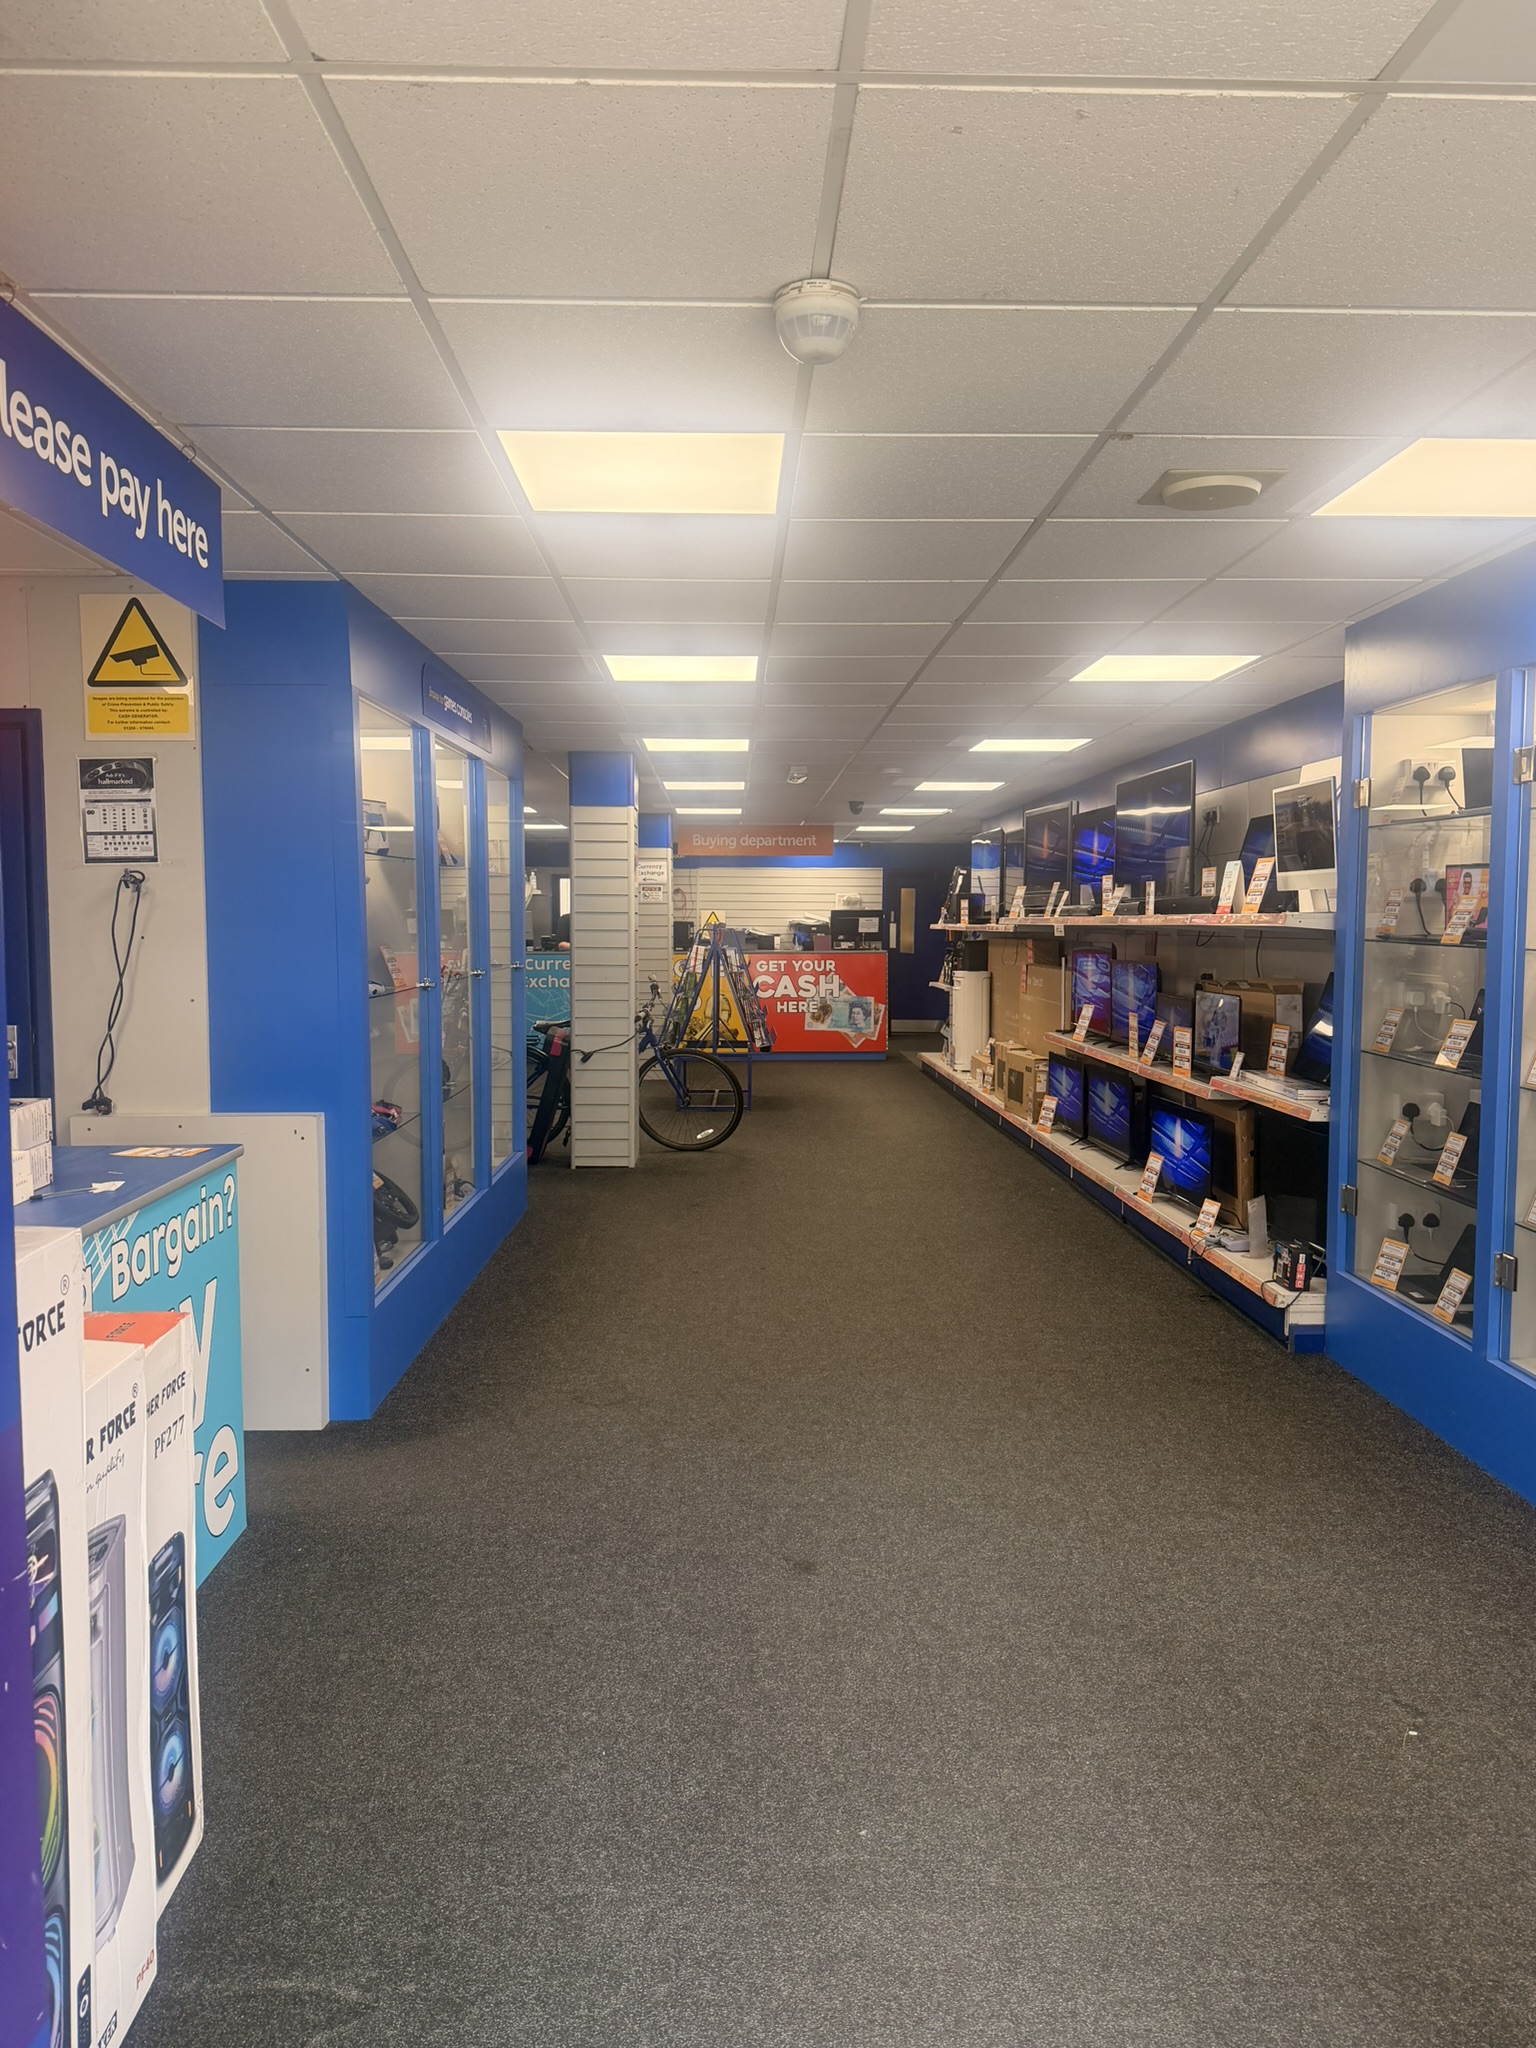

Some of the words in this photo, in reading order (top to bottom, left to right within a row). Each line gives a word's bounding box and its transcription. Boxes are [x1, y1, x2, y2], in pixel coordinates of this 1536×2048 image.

[0, 357, 92, 487] lease
[100, 450, 151, 540] pay
[156, 478, 209, 569] here
[692, 834, 737, 849] Buying
[739, 834, 817, 849] department
[753, 974, 841, 999] CASH
[756, 960, 788, 972] GET
[791, 960, 837, 972] YOUR
[776, 1001, 820, 1013] HERE
[110, 1173, 236, 1302] Bargain?
[17, 1299, 66, 1353] ORCE
[161, 1370, 186, 1406] FORCE
[99, 1400, 137, 1454] FORCE
[154, 1413, 185, 1460] PF277
